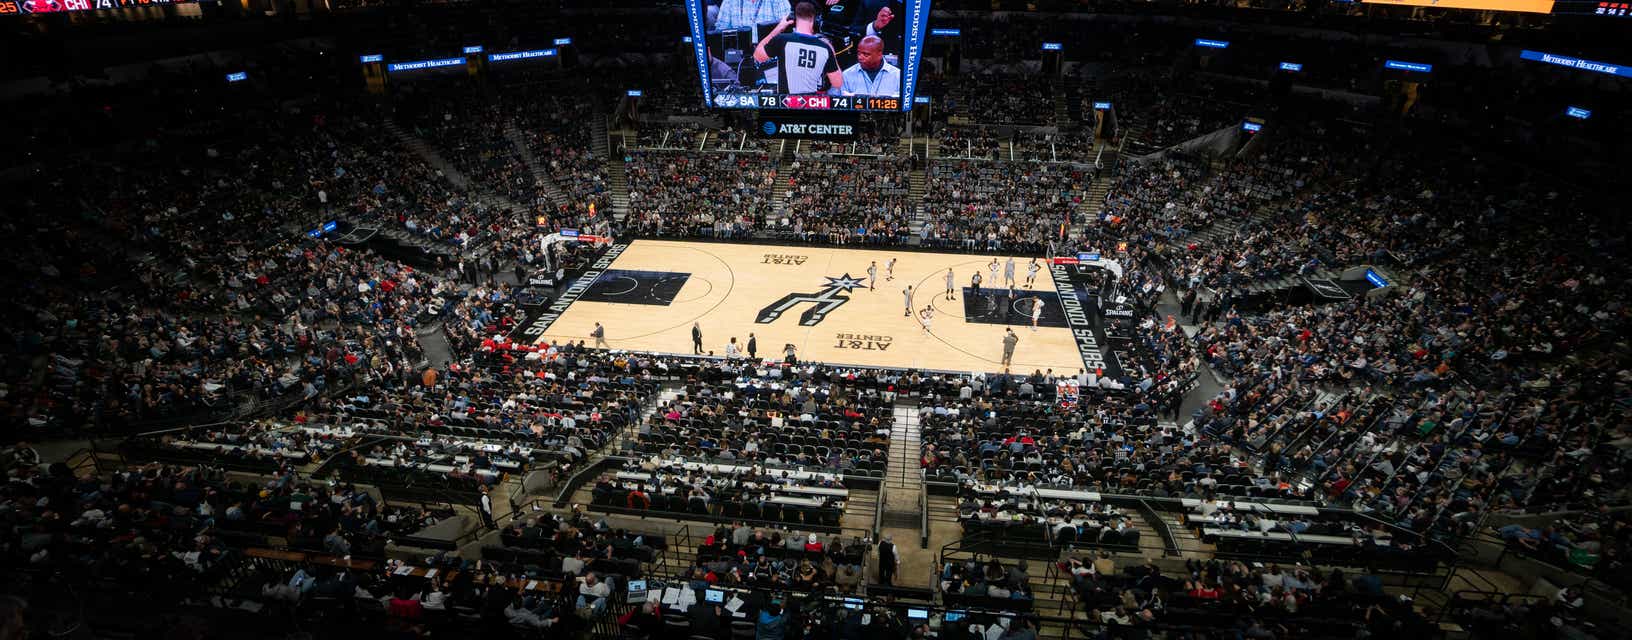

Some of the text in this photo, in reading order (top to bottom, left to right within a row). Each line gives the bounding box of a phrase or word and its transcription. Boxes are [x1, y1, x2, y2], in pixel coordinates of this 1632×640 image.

[65, 0, 90, 10] CHI
[394, 58, 461, 71] METHODIST HEALTHCARE
[798, 49, 817, 69] 29
[1543, 54, 1617, 74] METHODIST HEALTHCARE
[740, 97, 755, 106] SA
[762, 97, 776, 106] 78
[808, 98, 828, 108] CHI
[833, 98, 848, 108] 74
[869, 99, 897, 109] 11:25
[779, 124, 853, 135] AT&T CENTER
[1051, 264, 1071, 281] SAN
[524, 313, 559, 336] SAN
[549, 271, 601, 312] ANTONIO
[592, 243, 627, 269] SPURS
[1057, 282, 1088, 326] ANTONIO
[1105, 309, 1133, 318] SPALDING
[836, 333, 893, 342] CENTER
[834, 340, 892, 350] AT&T
[1074, 328, 1107, 370] SPURS
